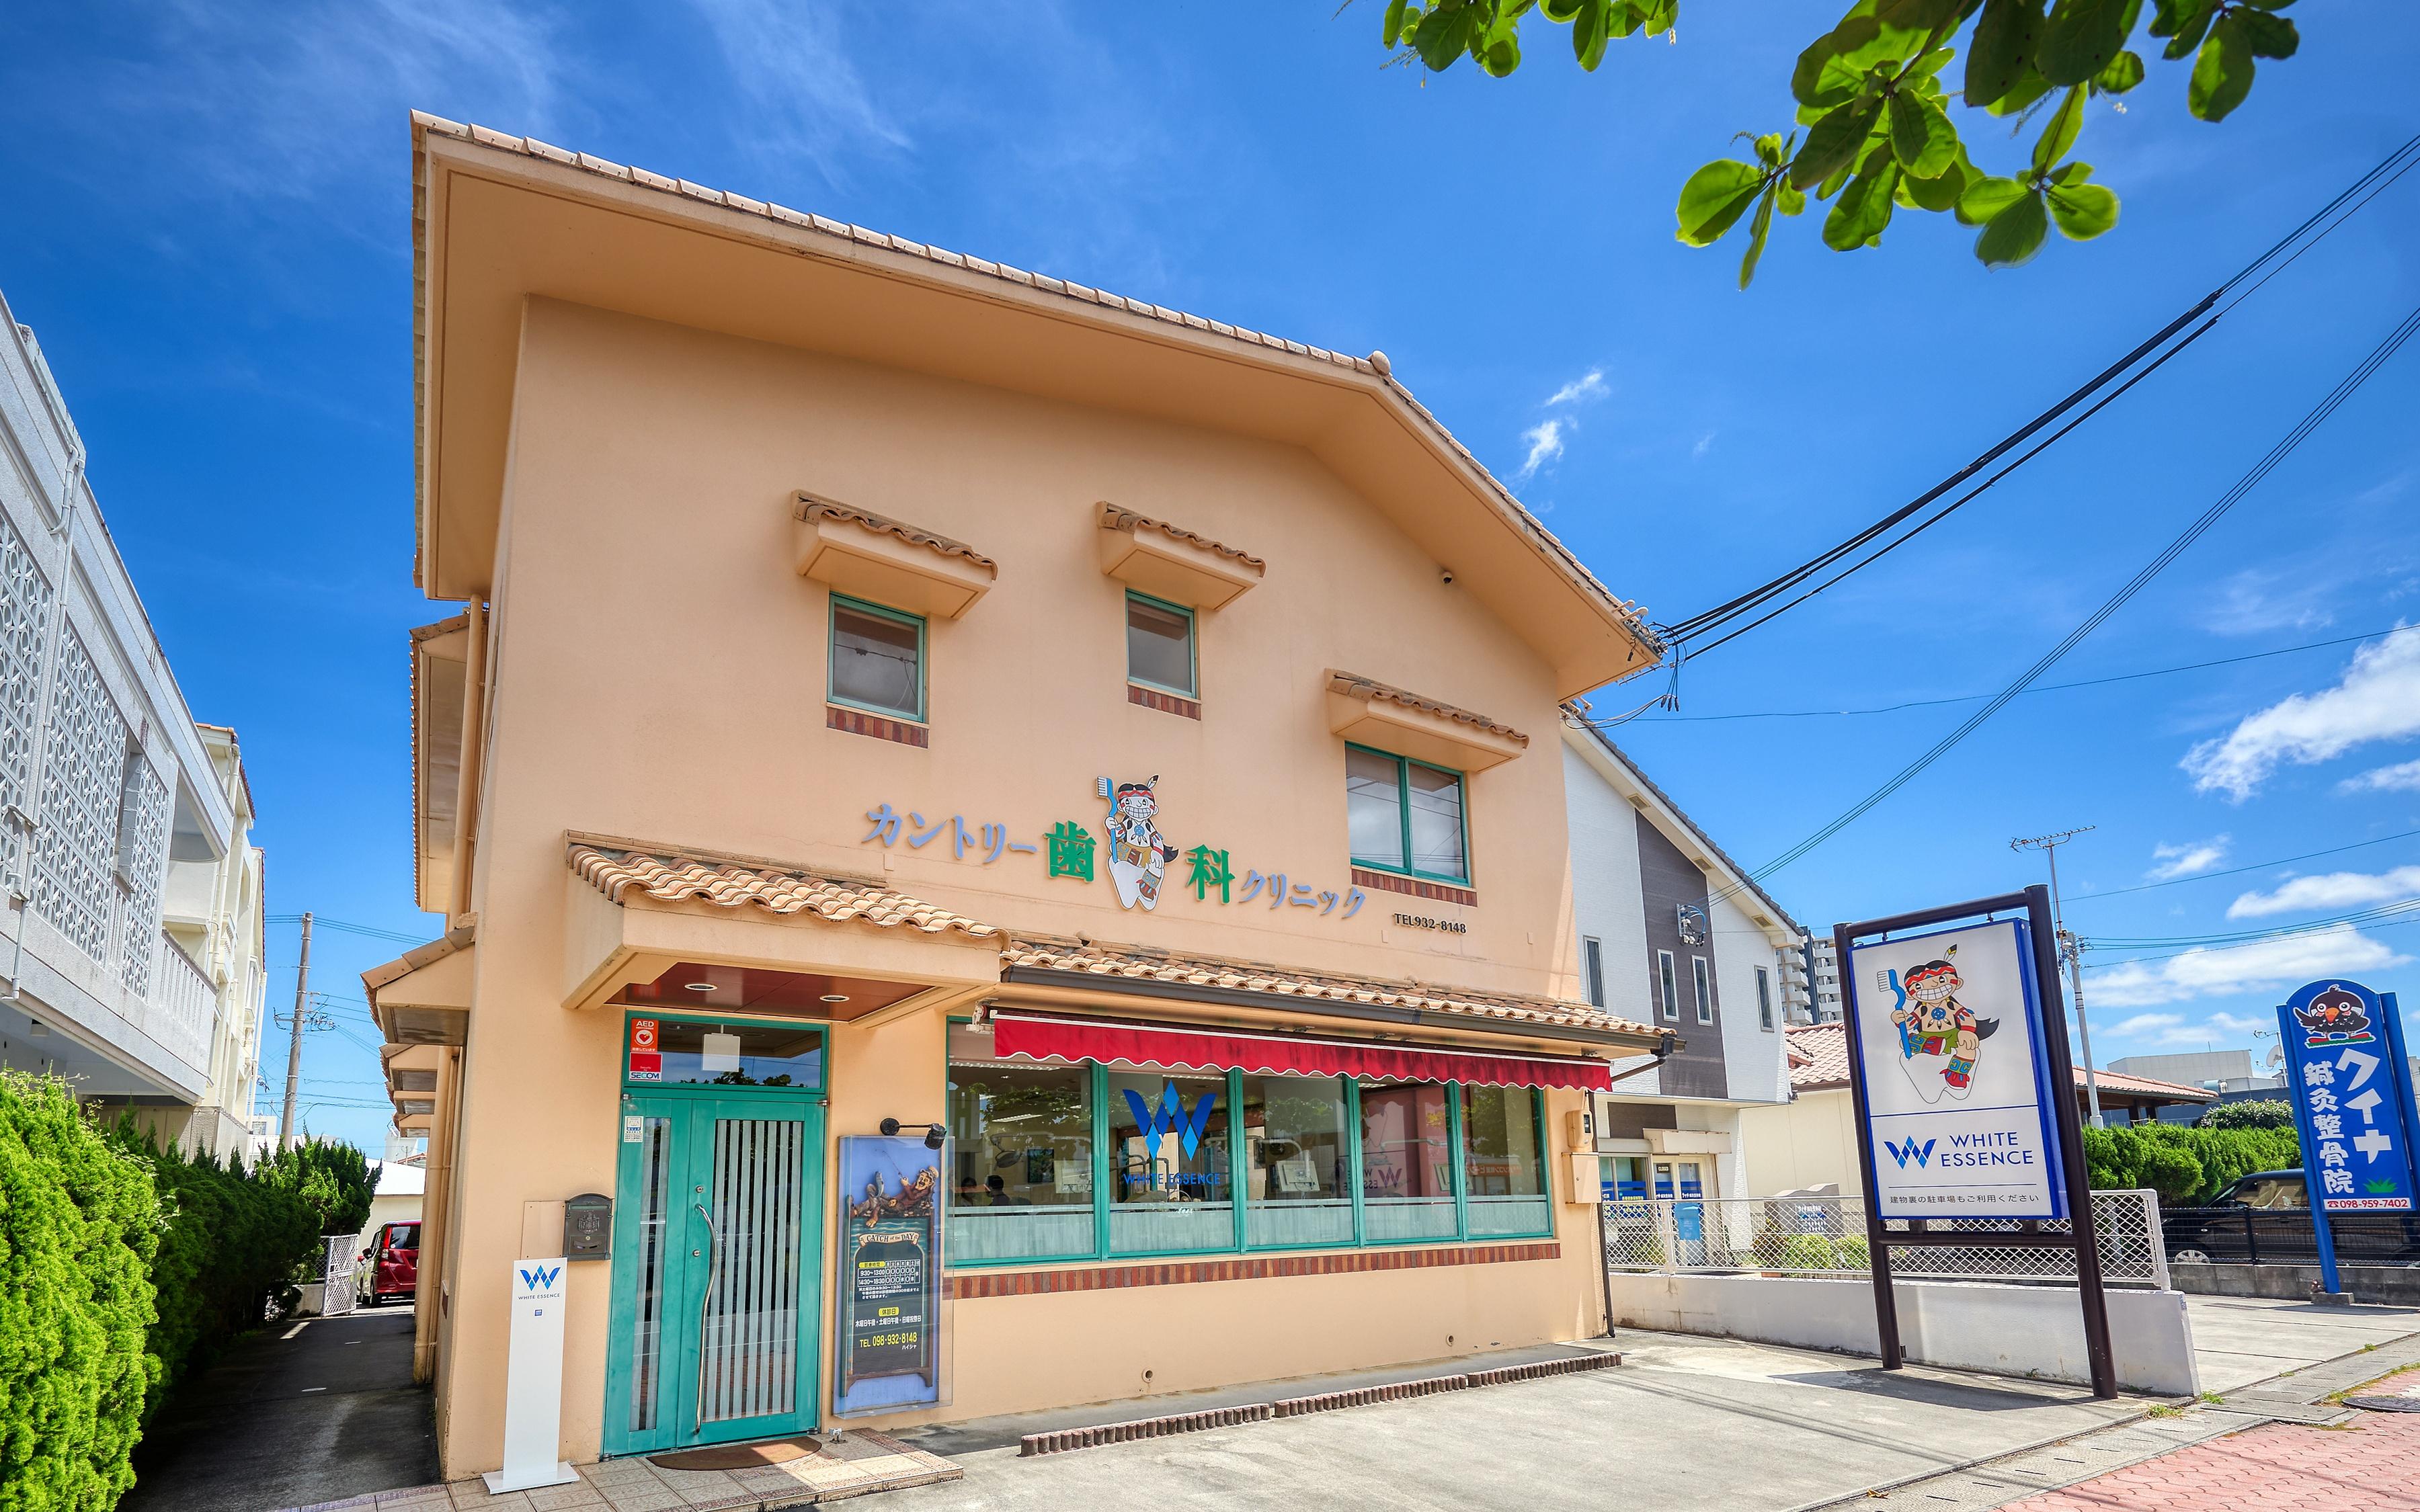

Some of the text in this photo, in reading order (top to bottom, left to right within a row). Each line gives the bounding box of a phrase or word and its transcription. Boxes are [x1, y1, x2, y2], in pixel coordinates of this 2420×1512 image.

[1394, 913, 1467, 934] TEL932-8148
[2335, 1048, 2392, 1165] クイナ
[2303, 1060, 2355, 1194] 鍼灸整骨院
[1949, 1132, 2019, 1148] WHITE
[1941, 1150, 2033, 1167] ESSENCE
[1123, 1173, 1221, 1185] WHITE ESSENCE
[1890, 1194, 2040, 1204] 建物裏の駐車場もご利用ください
[2340, 1200, 2408, 1208] 098-959-7402
[866, 1234, 889, 1243] CATCH
[860, 1339, 871, 1348] TEL
